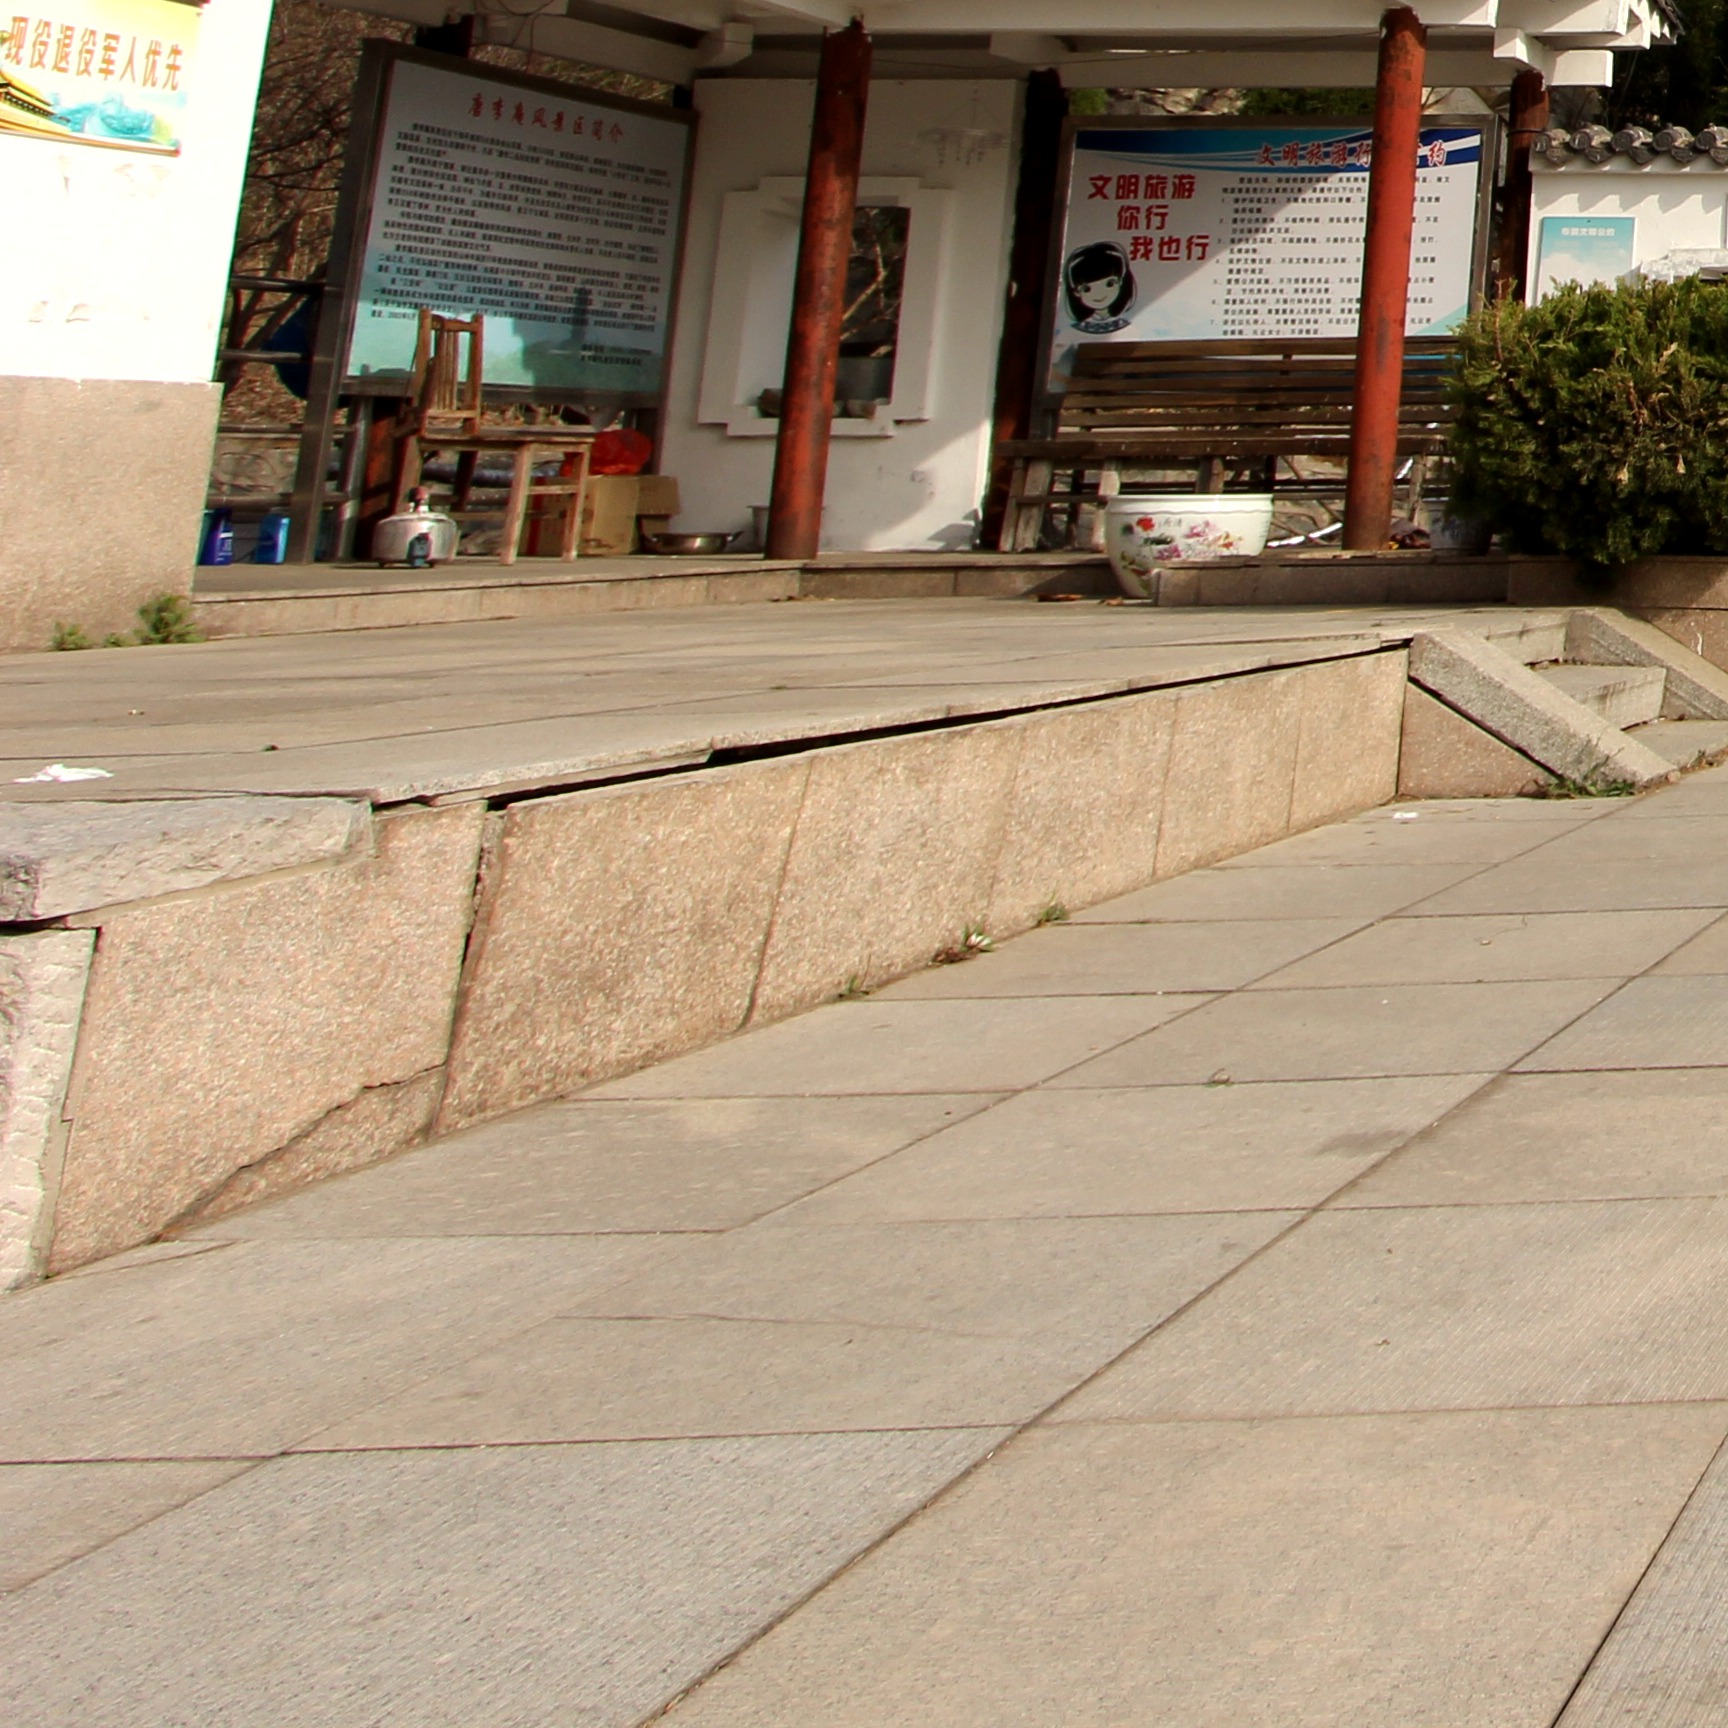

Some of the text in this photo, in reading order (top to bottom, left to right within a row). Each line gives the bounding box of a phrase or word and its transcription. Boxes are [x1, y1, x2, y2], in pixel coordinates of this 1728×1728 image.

[4, 15, 184, 92] 现役退役军人优先
[1087, 173, 1197, 201] 文明旅游
[1116, 204, 1170, 231] 你行
[1129, 235, 1211, 262] 我也行
